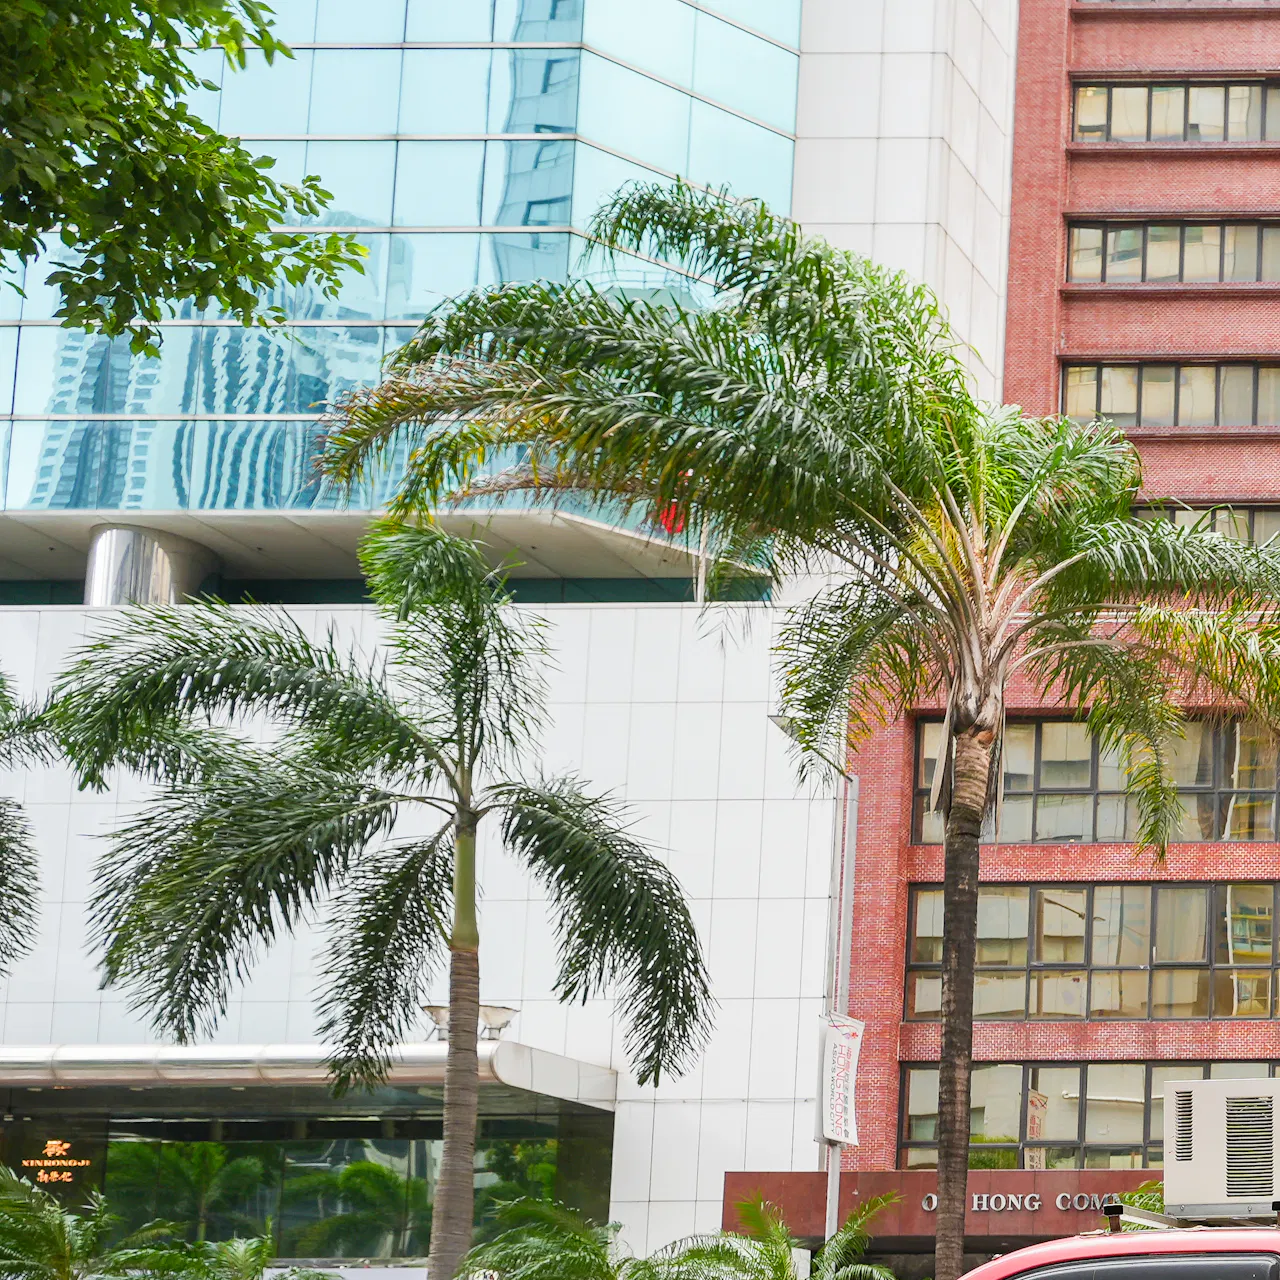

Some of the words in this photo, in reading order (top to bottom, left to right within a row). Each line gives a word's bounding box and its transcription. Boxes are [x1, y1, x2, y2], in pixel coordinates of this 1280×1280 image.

[835, 1044, 846, 1089] HONG
[834, 1092, 845, 1136] KONG
[971, 1192, 1043, 1212] HONG
